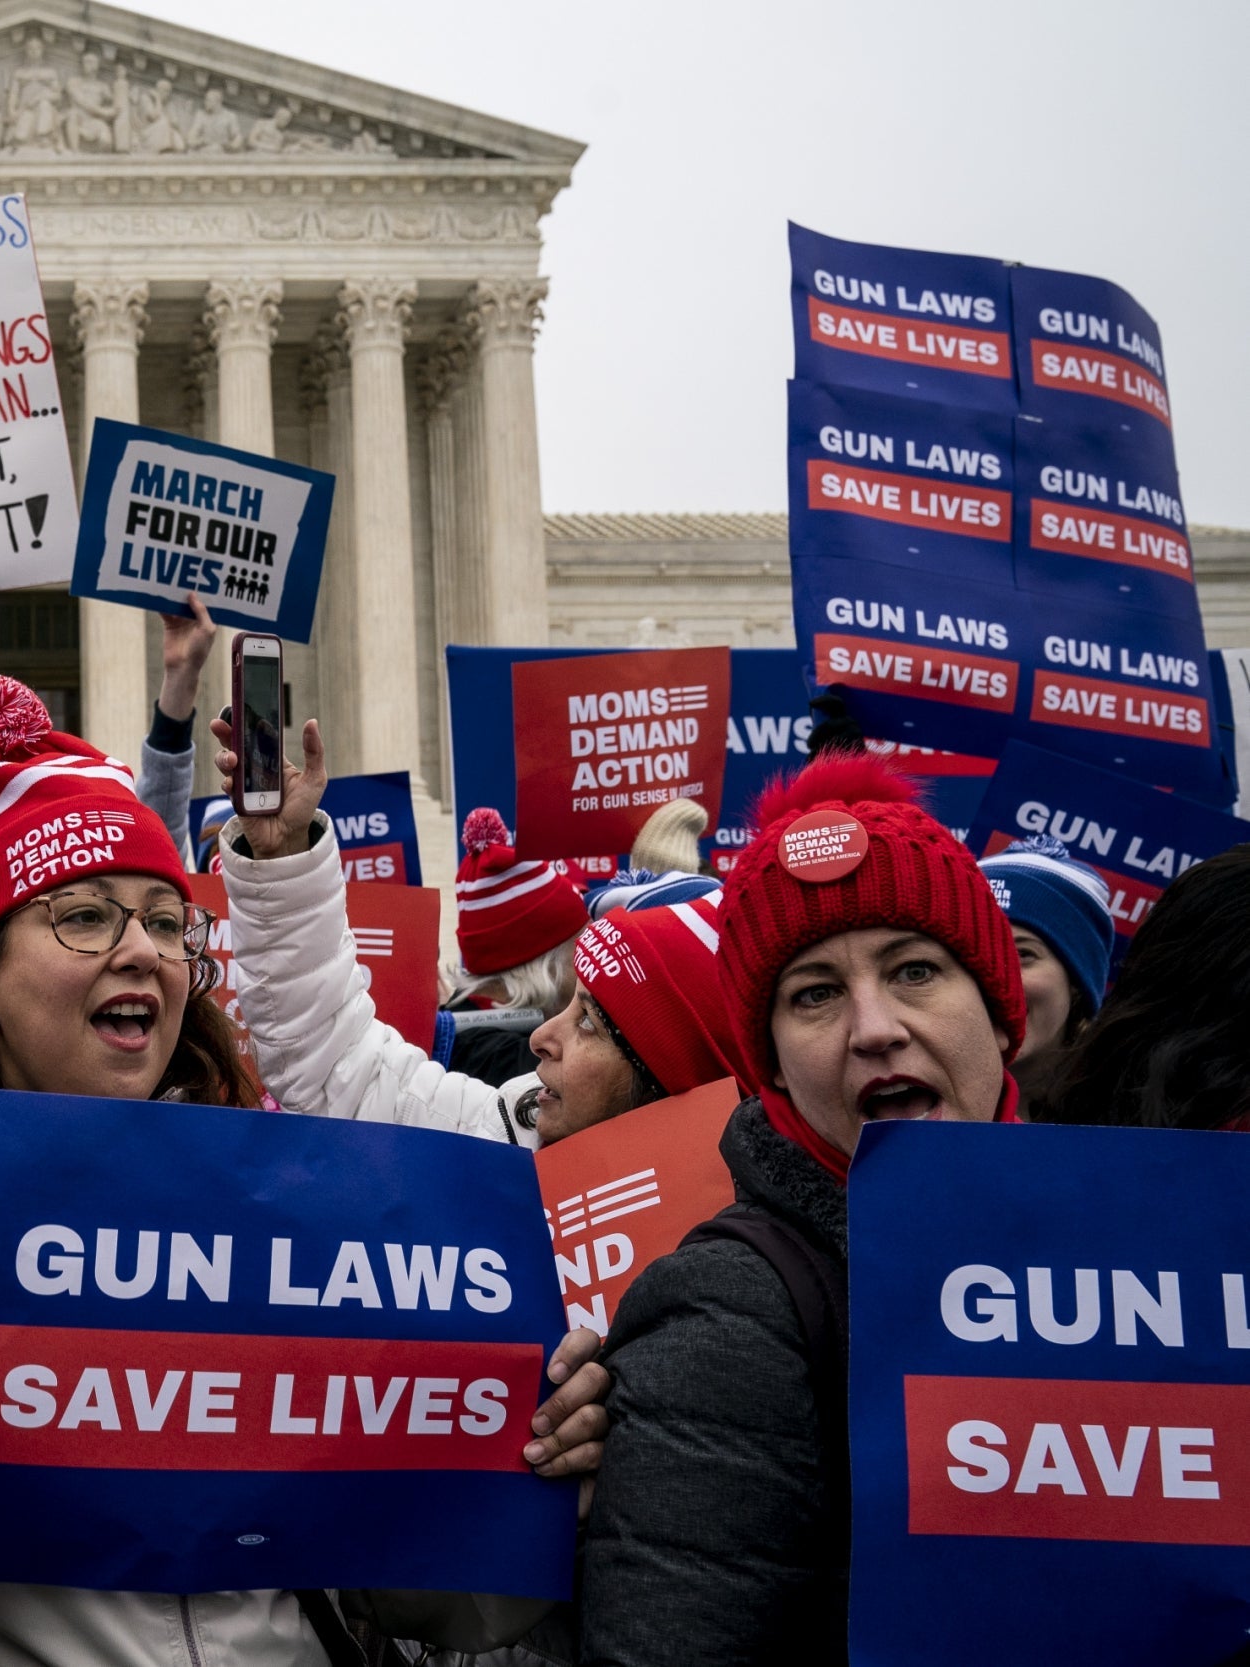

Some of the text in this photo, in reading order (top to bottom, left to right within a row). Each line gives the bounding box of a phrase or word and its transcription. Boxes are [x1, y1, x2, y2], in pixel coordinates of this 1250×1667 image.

[814, 269, 996, 323] GUN LAWS
[817, 311, 999, 365] SAVE LIVES
[1039, 307, 1109, 344] GUN
[1041, 352, 1117, 388] SAVE
[819, 426, 1002, 480] GUN LAWS
[130, 460, 264, 522] MARCH
[820, 473, 1001, 528] SAVE LIVES
[1040, 465, 1183, 526] GUN LAWS
[125, 500, 277, 567] FOR OUR
[1041, 513, 1188, 570] SAVE LIVES
[118, 541, 224, 595] LIVES
[826, 597, 1009, 650] GUN LAWS
[829, 646, 1008, 699] SAVE LIVES
[1044, 636, 1111, 672] GUN
[1120, 647, 1199, 687] LAWS
[568, 687, 669, 724] MOMS
[1042, 685, 1202, 734] SAVE LIVES
[570, 717, 699, 758] DEMAND
[726, 716, 812, 754] AWS
[571, 751, 689, 791] ACTION
[573, 796, 598, 812] FOR
[603, 793, 629, 809] GUN
[632, 788, 668, 806] SENSE
[5, 812, 83, 861] MOMS
[9, 825, 125, 880] DEMAND
[335, 812, 390, 841] WS
[785, 827, 830, 843] MOMS
[786, 833, 850, 852] DEMAND
[1016, 801, 1204, 878] GUN LA
[12, 845, 114, 898] ACTION
[343, 855, 395, 883] VES
[573, 857, 612, 873] VES
[787, 844, 843, 862] ACTION
[574, 945, 600, 983] TION
[579, 927, 621, 977] EMAND
[15, 1224, 233, 1303] GUN
[269, 1237, 513, 1313] LAWS
[940, 1264, 1185, 1347] GUN
[0, 1364, 509, 1436] SAVE LIVES
[946, 1419, 1220, 1500] SAVE
